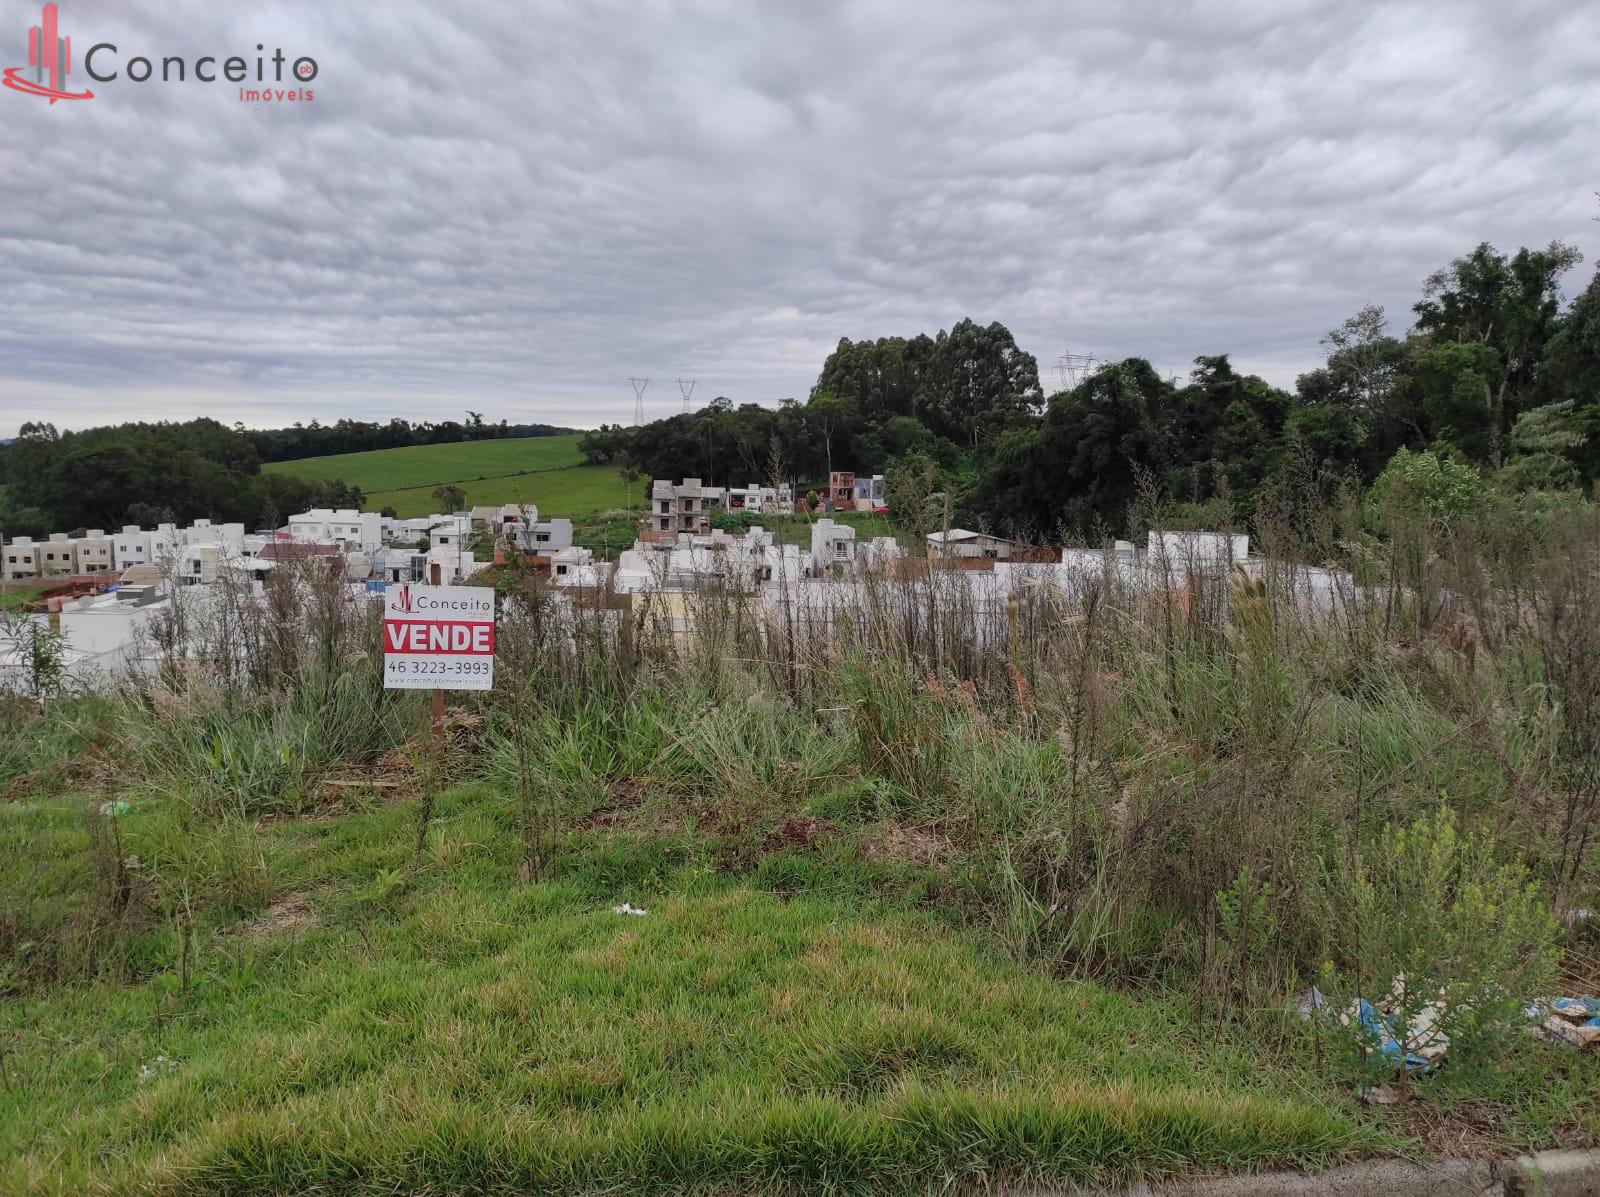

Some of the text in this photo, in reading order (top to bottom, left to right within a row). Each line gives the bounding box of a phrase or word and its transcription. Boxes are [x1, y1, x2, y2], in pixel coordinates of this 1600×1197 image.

[417, 596, 490, 611] Conceito
[387, 624, 490, 652] VENDE
[388, 661, 489, 675] 46 3223-3993
